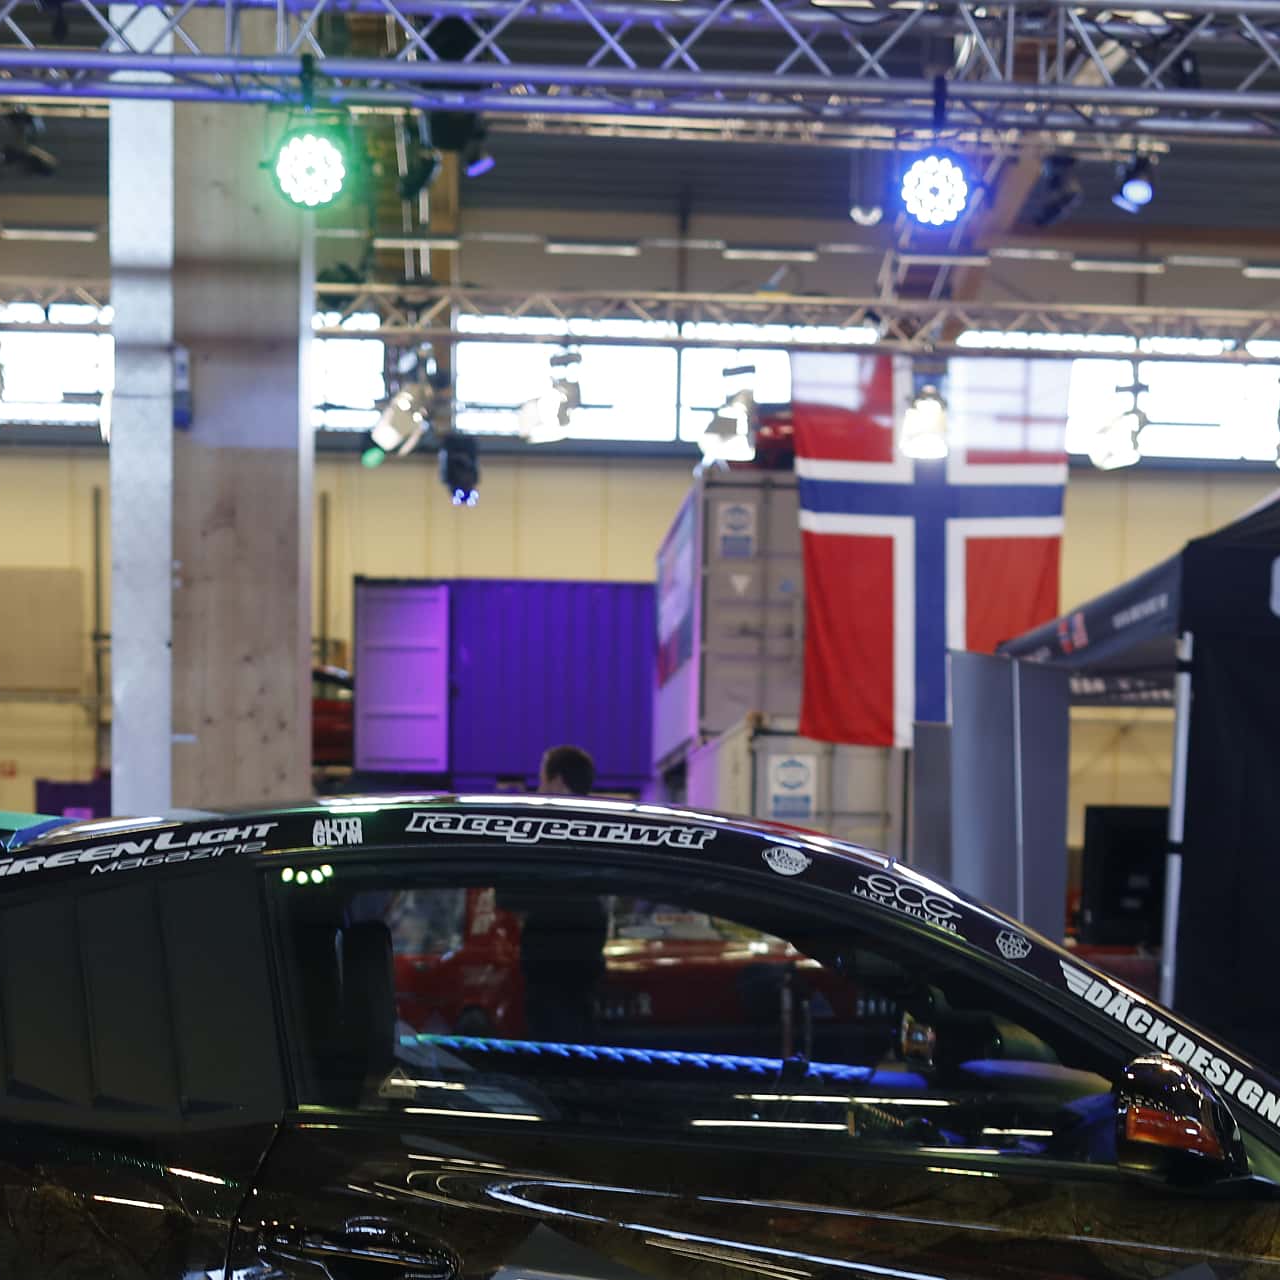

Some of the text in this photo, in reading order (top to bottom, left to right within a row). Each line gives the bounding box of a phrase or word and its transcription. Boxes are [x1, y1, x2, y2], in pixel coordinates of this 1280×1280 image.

[313, 817, 362, 832] AUTO
[406, 812, 717, 849] racegear.wtf
[313, 830, 363, 847] GLYM
